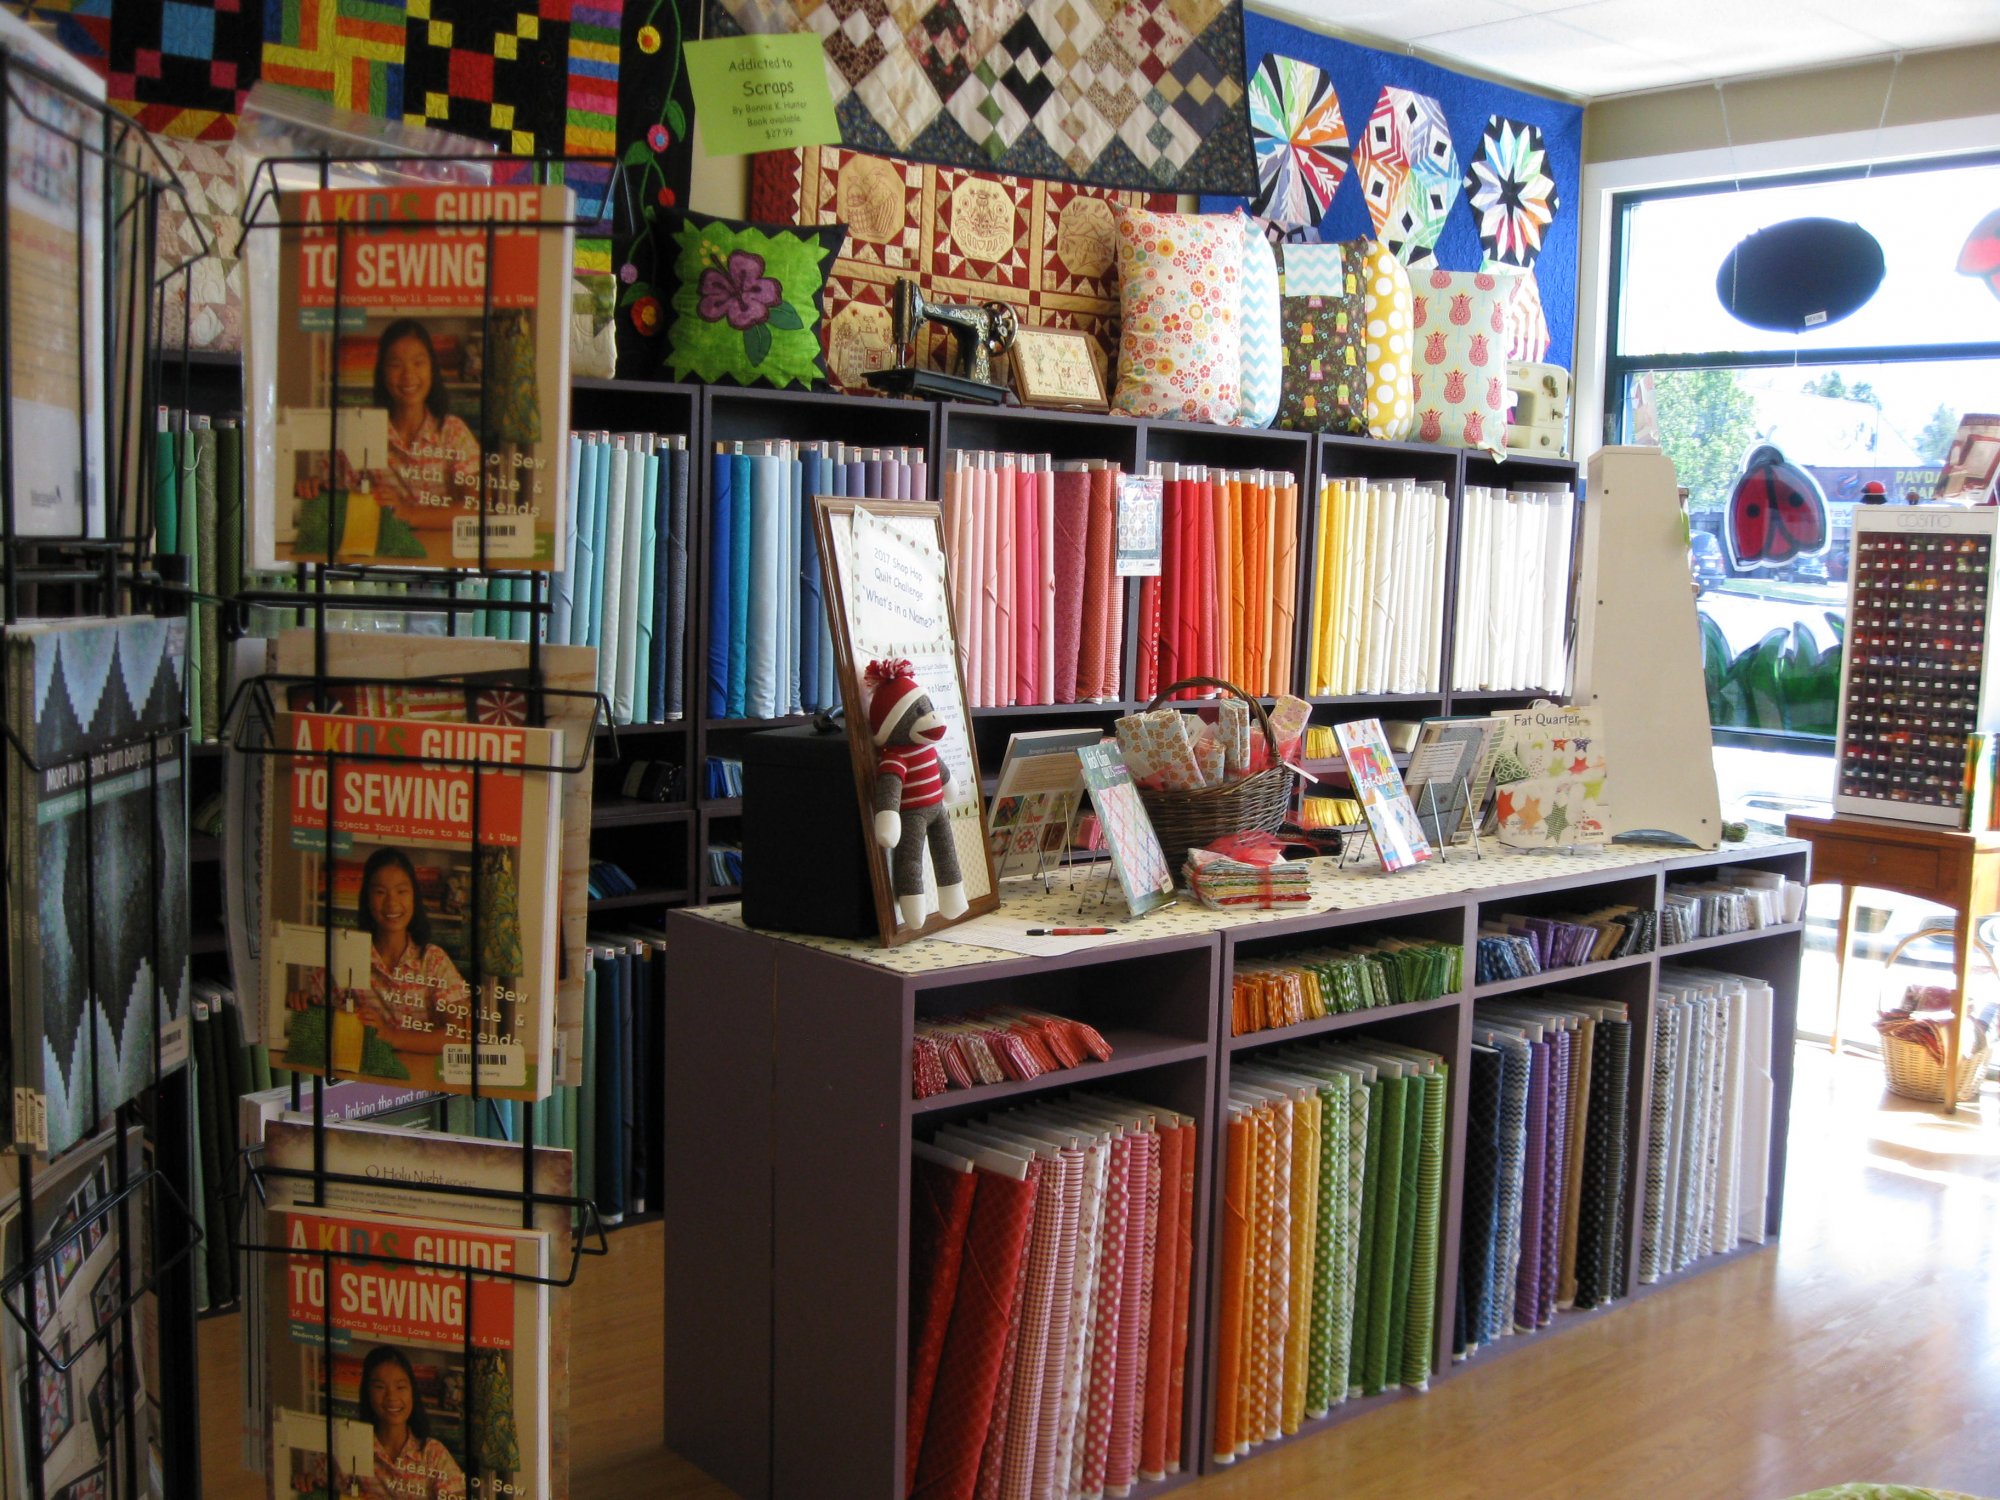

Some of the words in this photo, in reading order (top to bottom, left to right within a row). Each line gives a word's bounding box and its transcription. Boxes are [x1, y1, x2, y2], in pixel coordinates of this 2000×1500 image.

[728, 58, 780, 72] Addicted
[782, 58, 793, 68] to
[743, 80, 794, 97] Scraps
[732, 105, 742, 115] By
[745, 104, 773, 113] Bonnie
[747, 117, 768, 127] Book
[769, 114, 801, 124] available
[303, 194, 324, 237] A
[335, 193, 420, 236] KID'S
[435, 192, 537, 236] GUIDE
[303, 245, 338, 288] TO
[355, 243, 486, 288] SEWING
[411, 442, 467, 461] Learn
[512, 453, 547, 469] Sew
[400, 466, 443, 483] with
[533, 481, 543, 494] &
[419, 491, 452, 508] Her
[874, 547, 890, 564] 2017
[893, 558, 908, 576] Shop
[911, 567, 922, 583] Hop
[875, 568, 892, 585] Quilt
[894, 601, 901, 615] in
[1514, 714, 1532, 727] Fat
[294, 719, 313, 761] A
[324, 721, 407, 768] KID'S
[420, 729, 522, 777] GUIDE
[294, 767, 328, 811] TO
[344, 772, 469, 823] SEWING
[307, 817, 323, 826] Fun
[331, 820, 369, 831] rojects
[375, 823, 405, 833] You'll
[411, 826, 434, 836] Love
[441, 829, 452, 837] to
[500, 833, 518, 842] Use
[393, 967, 448, 989] Learn
[462, 979, 481, 997] t
[494, 985, 528, 1003] Sew
[382, 990, 424, 1008] with
[436, 1000, 501, 1022] Sopie
[515, 1014, 524, 1026] &
[402, 1014, 434, 1032] Her
[378, 1095, 392, 1110] the
[365, 1164, 380, 1178] O
[414, 1170, 443, 1184] Night
[290, 1220, 307, 1258] A
[318, 1223, 398, 1272] KID'S
[414, 1236, 511, 1284] GUIDE
[290, 1264, 325, 1308] TO
[340, 1272, 463, 1326] SEWING
[305, 1312, 321, 1320] Fun
[330, 1316, 367, 1328] rojects
[372, 1322, 401, 1334] You'll
[408, 1327, 431, 1337] Love
[437, 1331, 447, 1339] to
[453, 1333, 476, 1342] Mae
[493, 1337, 510, 1346] Use
[385, 1478, 427, 1497] with
[396, 1457, 448, 1480] Learn
[493, 1478, 526, 1497] Sew
